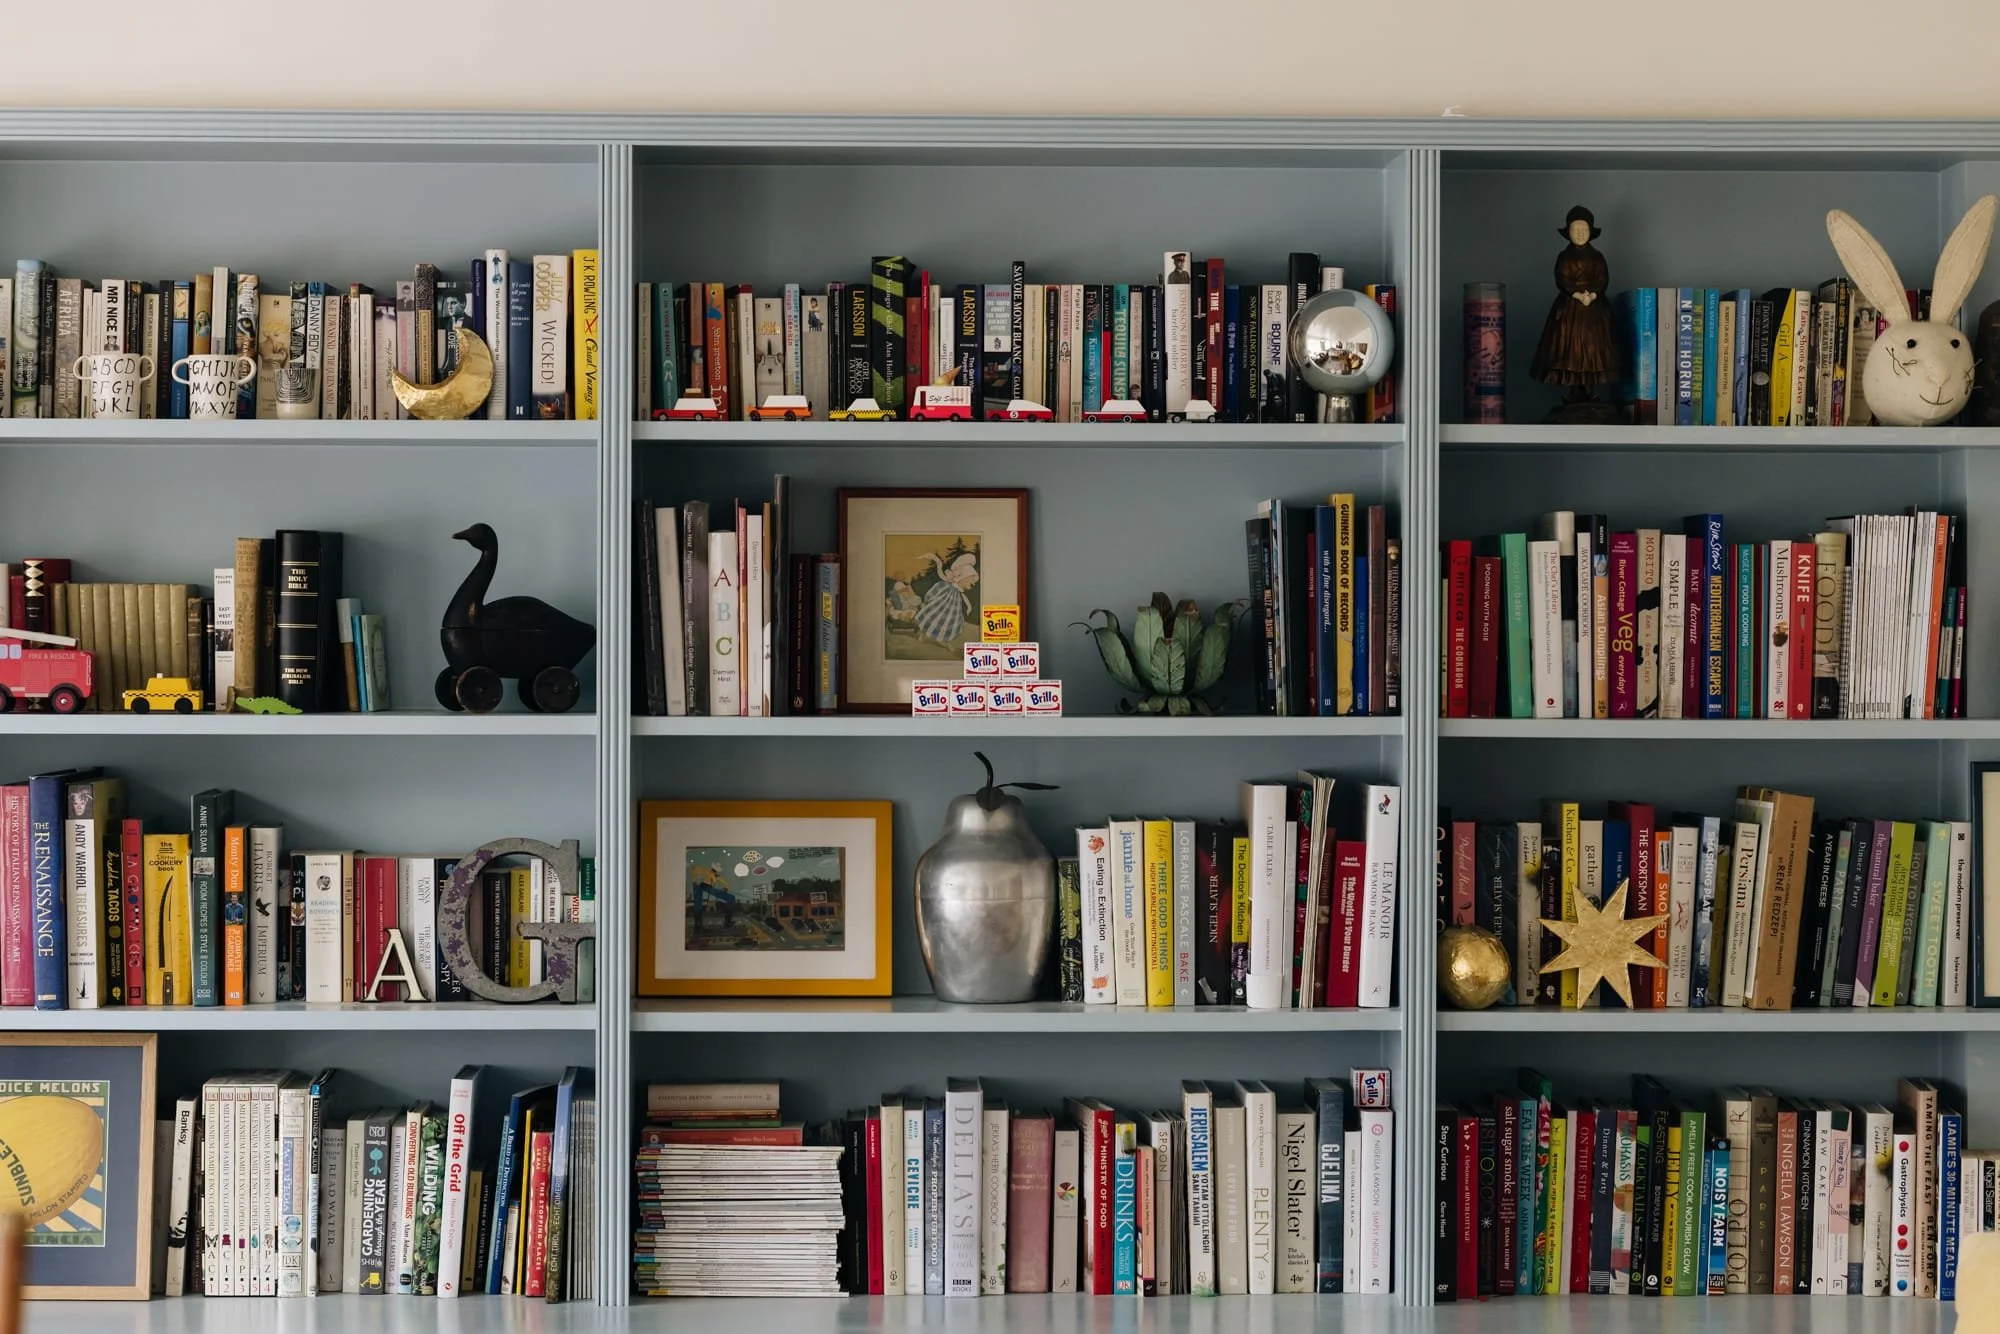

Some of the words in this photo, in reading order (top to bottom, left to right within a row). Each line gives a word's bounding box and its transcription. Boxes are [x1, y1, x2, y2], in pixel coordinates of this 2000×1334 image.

[583, 257, 595, 273] J.K.
[108, 286, 118, 303] MR
[537, 262, 550, 311] COOPER
[552, 273, 562, 303] JILLY
[1013, 266, 1022, 299] SAVOIE
[59, 290, 72, 335] AFRICA
[310, 300, 320, 332] DANNY
[853, 291, 864, 336] LARSSON
[963, 290, 975, 335] LARSSON
[1013, 302, 1022, 329] MONT
[1210, 293, 1219, 311] TIME
[1681, 300, 1692, 331] NICK
[107, 308, 117, 331] NICE
[712, 327, 721, 345] john
[1115, 309, 1127, 357] TEQUILA
[1760, 306, 1768, 335] DONNA
[1779, 324, 1790, 347] Girl
[309, 334, 320, 353] BOY
[542, 320, 556, 384] WICKED!
[585, 338, 598, 366] Casual
[1013, 333, 1022, 364] BLANC
[1272, 324, 1281, 365] BOURNE
[1760, 337, 1768, 363] TARTT
[1779, 353, 1789, 361] A
[1799, 336, 1807, 362] Shoots
[712, 348, 722, 380] preston
[1680, 350, 1692, 407] HORNBY
[584, 371, 596, 404] Vacancy
[1797, 376, 1805, 404] Leaves
[1340, 504, 1349, 546] GUINNESS
[714, 569, 731, 586] A
[1340, 550, 1349, 574] BOOK
[1644, 537, 1654, 585] MORITO
[1340, 578, 1349, 589] OF
[1669, 560, 1679, 609] SIMPLE
[1691, 569, 1699, 593] BAKE
[1775, 547, 1789, 619] Mushrooms
[1797, 555, 1810, 602] KNIFE
[717, 603, 731, 621] B
[1340, 592, 1349, 632] RECORDS
[1597, 595, 1606, 620] Asian
[1709, 576, 1722, 651] MEDITERRANEAN
[1815, 562, 1836, 644] FOOD
[987, 619, 1013, 631] Brillo
[1456, 628, 1464, 642] THE
[1689, 603, 1700, 644] decorate
[716, 637, 733, 655] C
[970, 655, 998, 668] Brillo
[1008, 655, 1035, 668] Brillo
[1596, 622, 1606, 680] Dumplings
[1455, 646, 1464, 689] COOKBOOK
[1709, 656, 1721, 695] ESCAPES
[919, 693, 946, 706] Brillo
[957, 692, 983, 706] Brillo
[994, 693, 1021, 706] Brillo
[1031, 691, 1058, 705] Brillo
[75, 824, 86, 849] ANDY
[1566, 808, 1576, 844] Kitchen
[1639, 828, 1648, 848] THE
[229, 837, 239, 865] Monty
[1179, 830, 1189, 891] LORRAINE
[1237, 843, 1247, 861] The
[1566, 846, 1575, 857] &
[1566, 858, 1575, 875] Co.
[1585, 845, 1598, 887] gather
[1957, 859, 1965, 872] the
[76, 852, 86, 890] WARHOL
[231, 869, 239, 888] Don
[1096, 857, 1105, 886] Eating
[1158, 861, 1167, 895] THREE
[1237, 863, 1247, 901] Doctor's
[1383, 862, 1393, 879] LE
[1638, 850, 1648, 911] SPORTSMAN
[1735, 848, 1754, 909] Persiana
[1775, 865, 1785, 892] RENÉ
[1956, 873, 1964, 902] modern
[34, 832, 54, 957] RENAISSANCE
[108, 889, 119, 921] TACOS
[200, 881, 208, 900] ROOM
[1098, 887, 1105, 895] to
[1930, 880, 1944, 930] SWEET
[76, 893, 87, 946] TREASURES
[200, 902, 208, 927] RECIPES
[437, 837, 596, 1004] G
[1097, 897, 1107, 941] Extinction
[1159, 898, 1167, 928] GOOD
[1179, 896, 1188, 947] PASCALE
[1237, 902, 1246, 936] Kitchen
[1380, 883, 1392, 939] MANOIR
[1770, 896, 1782, 937] REDZEPI
[257, 926, 268, 975] IMPERIUM
[364, 928, 430, 1002] A
[1159, 932, 1168, 971] THINGS
[1179, 952, 1188, 982] BAKE
[1925, 937, 1938, 987] TOOTH
[40, 1083, 100, 1093] MELONS
[1364, 1077, 1379, 1104] Brillo
[453, 1114, 465, 1135] Off
[1505, 1106, 1516, 1125] salt
[452, 1138, 464, 1159] the
[1159, 1131, 1168, 1173] SPOON
[1190, 1107, 1208, 1171] JERUSALEM
[1281, 1123, 1307, 1173] Nigel
[1440, 1126, 1449, 1146] Stay
[1501, 1128, 1514, 1156] sugar
[1947, 1121, 1956, 1168] JAMIE'S
[0, 1138, 36, 1206] SUNBLE
[327, 1164, 336, 1197] READ
[422, 1144, 440, 1215] WILDING
[449, 1164, 462, 1192] Grid
[953, 1106, 974, 1228] DELIA'S
[1321, 1144, 1341, 1203] GJELINA
[1440, 1147, 1448, 1181] Curious
[1504, 1158, 1515, 1194] smoke
[1666, 1148, 1680, 1201] JELLY
[1781, 1143, 1792, 1199] NIGELLA
[30, 1203, 58, 1219] MELON
[58, 1174, 89, 1204] STAMPED
[375, 1179, 386, 1212] YEAR
[907, 1159, 920, 1209] CEVICHE
[1100, 1189, 1107, 1200] OF
[1715, 1168, 1727, 1208] NOISY
[1898, 1158, 1909, 1217] Gastrophysics
[363, 1179, 375, 1256] GARDENING
[1116, 1161, 1134, 1242] DRINKS
[1287, 1179, 1306, 1238] Slater
[1945, 1171, 1956, 1234] 30-MINUTE
[327, 1201, 336, 1246] WATER
[1254, 1188, 1270, 1264] PLENTY
[1713, 1212, 1725, 1247] FARM
[1779, 1206, 1791, 1268] LAWSON
[1945, 1237, 1955, 1278] MEALS
